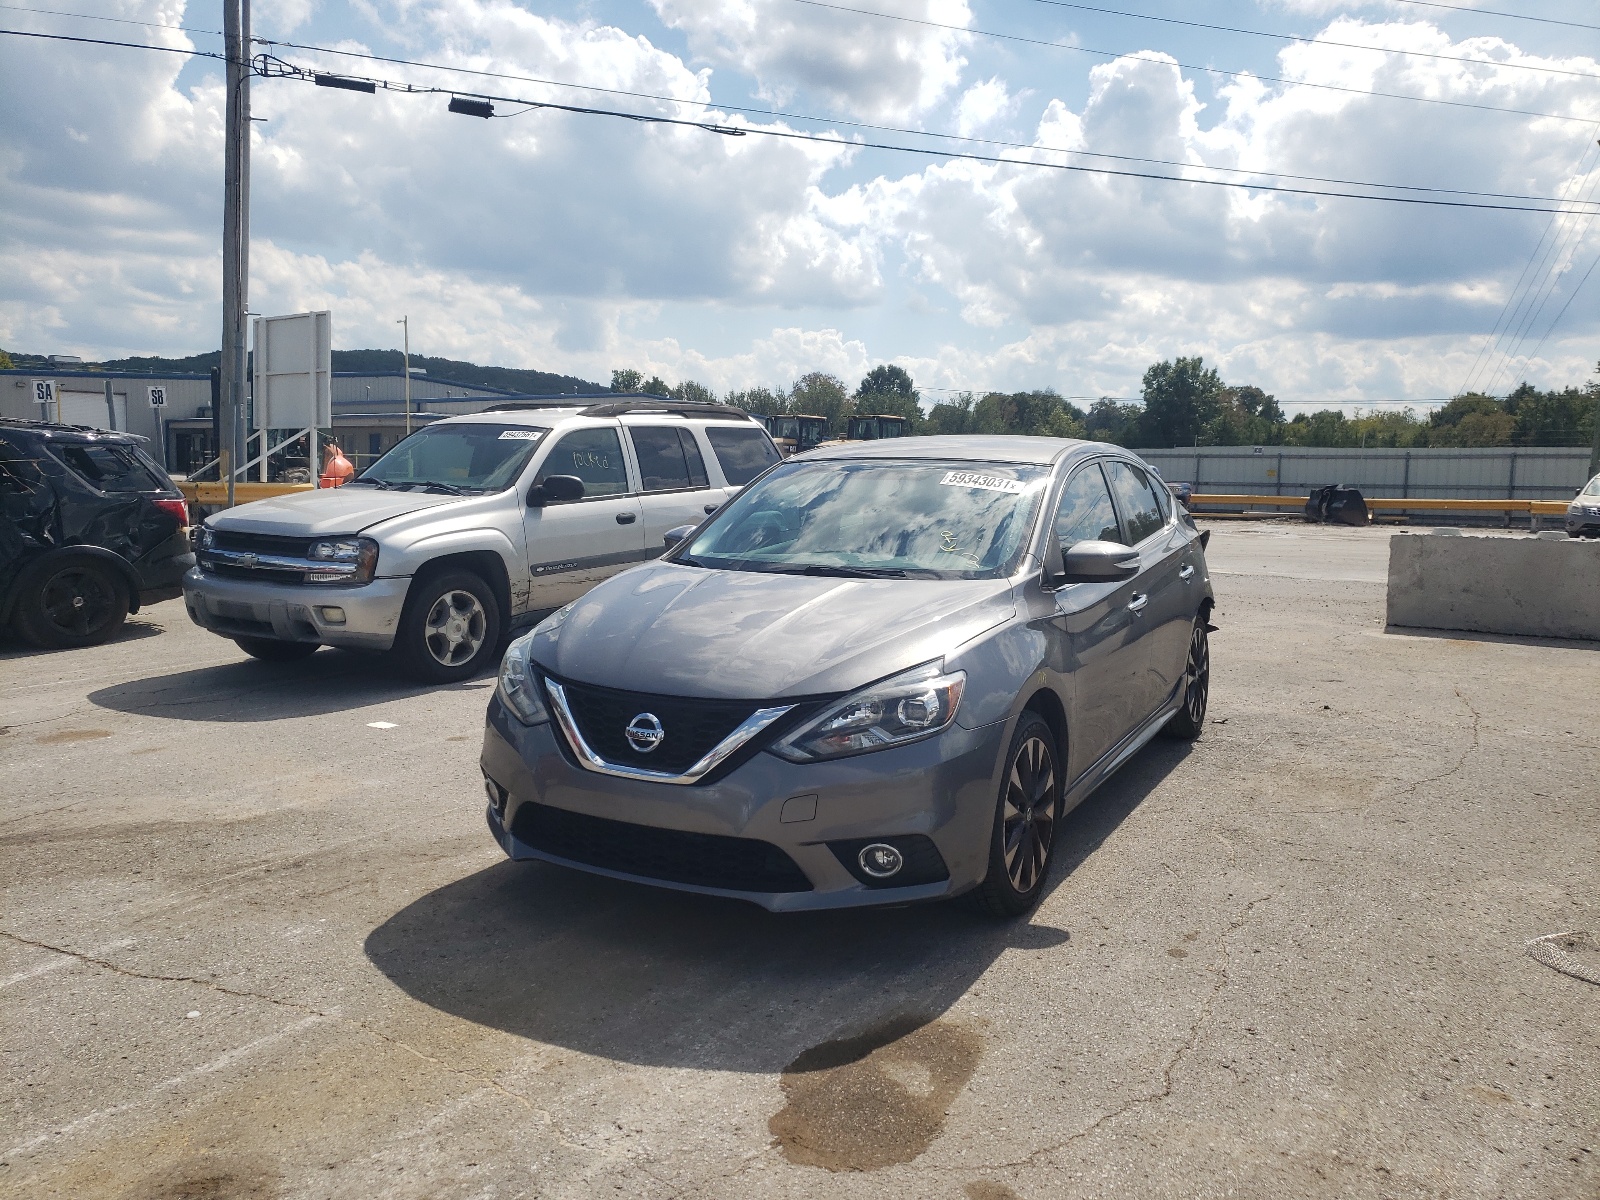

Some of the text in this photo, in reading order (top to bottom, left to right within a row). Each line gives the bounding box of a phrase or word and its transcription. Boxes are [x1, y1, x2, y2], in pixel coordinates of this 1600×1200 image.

[36, 382, 53, 400] SA
[151, 389, 164, 405] SB
[627, 729, 659, 739] NISSAN
